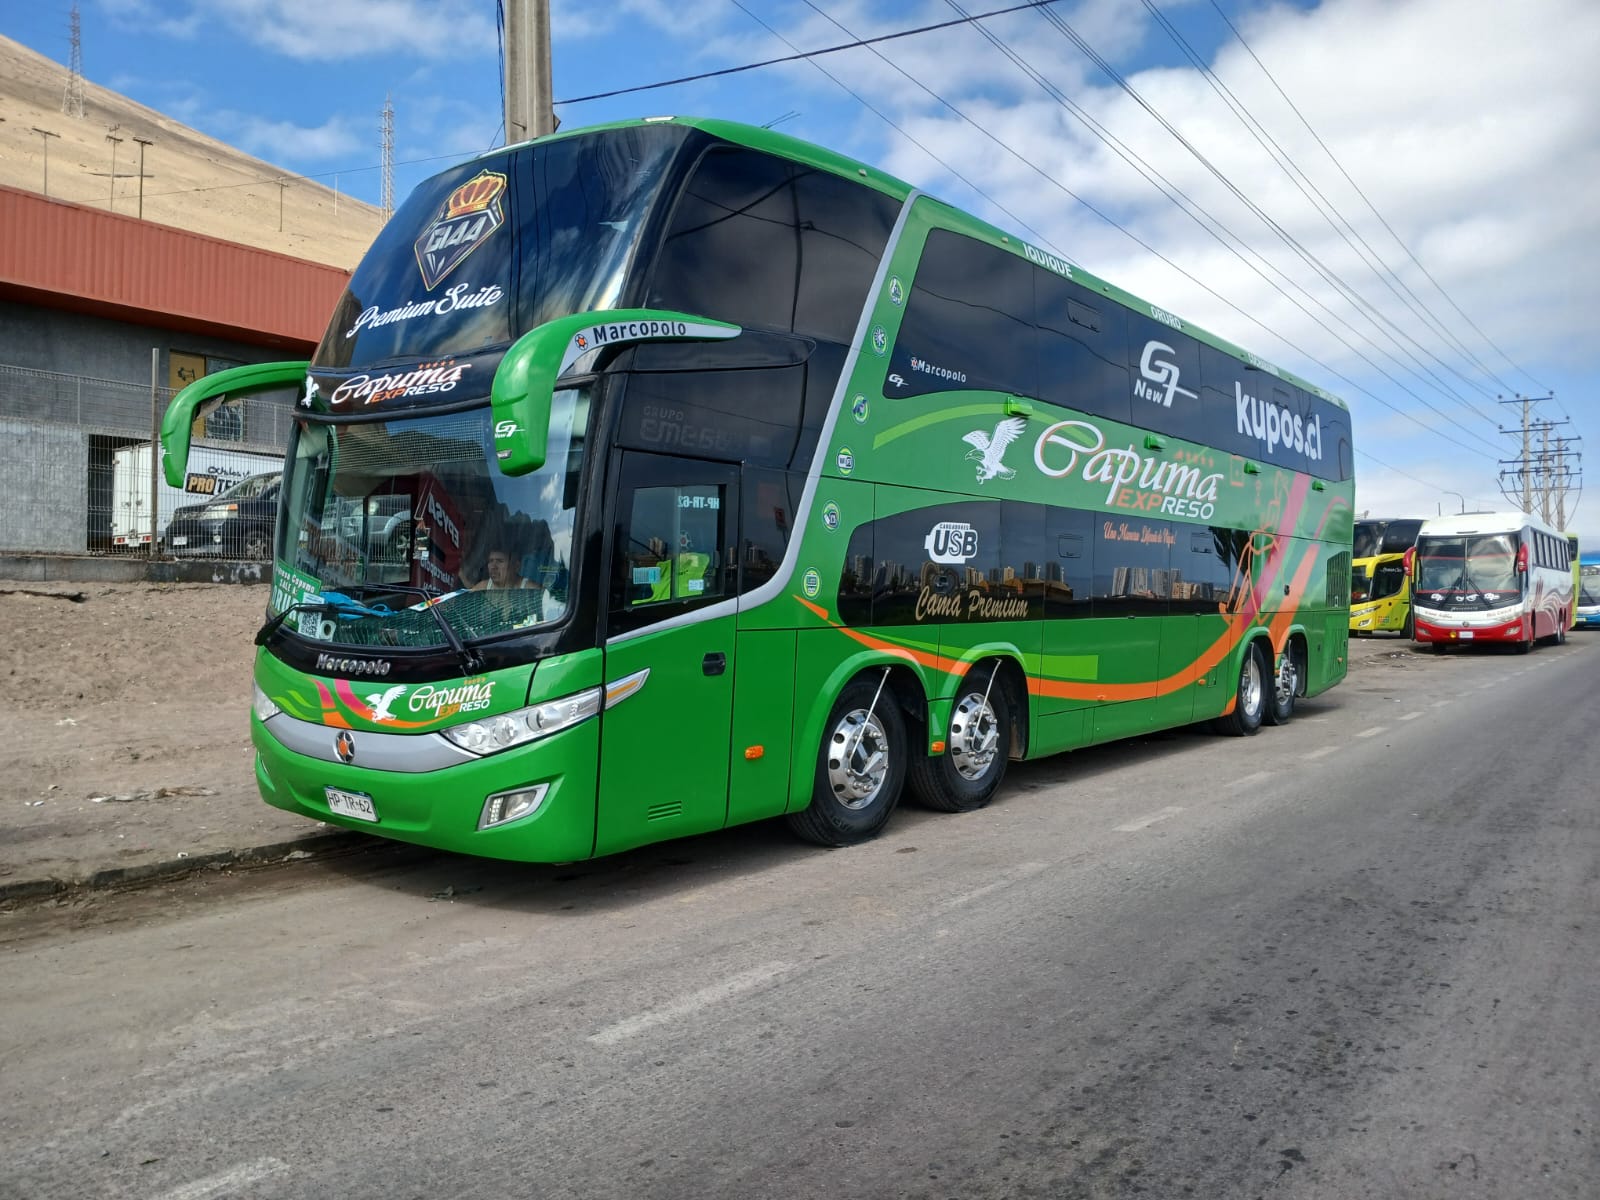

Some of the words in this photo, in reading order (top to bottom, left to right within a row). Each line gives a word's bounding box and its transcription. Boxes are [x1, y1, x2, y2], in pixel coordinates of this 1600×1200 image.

[1023, 242, 1073, 279] IQUIQUE
[346, 299, 441, 339] Premium
[435, 283, 505, 317] Suite
[1150, 306, 1182, 330] ORURO
[593, 321, 687, 345] Marcopolo
[331, 362, 472, 405] Capuma
[917, 359, 967, 383] Marcopolo
[372, 381, 457, 404] EXPRESO
[1134, 378, 1164, 404] New
[643, 405, 684, 421] GRUPO
[1235, 380, 1322, 460] kupos.cl
[1033, 420, 1224, 505] Capuma
[187, 476, 215, 493] PRO
[1116, 488, 1214, 520] EXPRESO
[933, 530, 977, 557] USB
[915, 585, 962, 621] Cama
[967, 590, 1029, 620] Premium
[316, 652, 391, 676] Marcopolo
[408, 681, 496, 717] Capuma
[438, 698, 490, 717] EXPRESO
